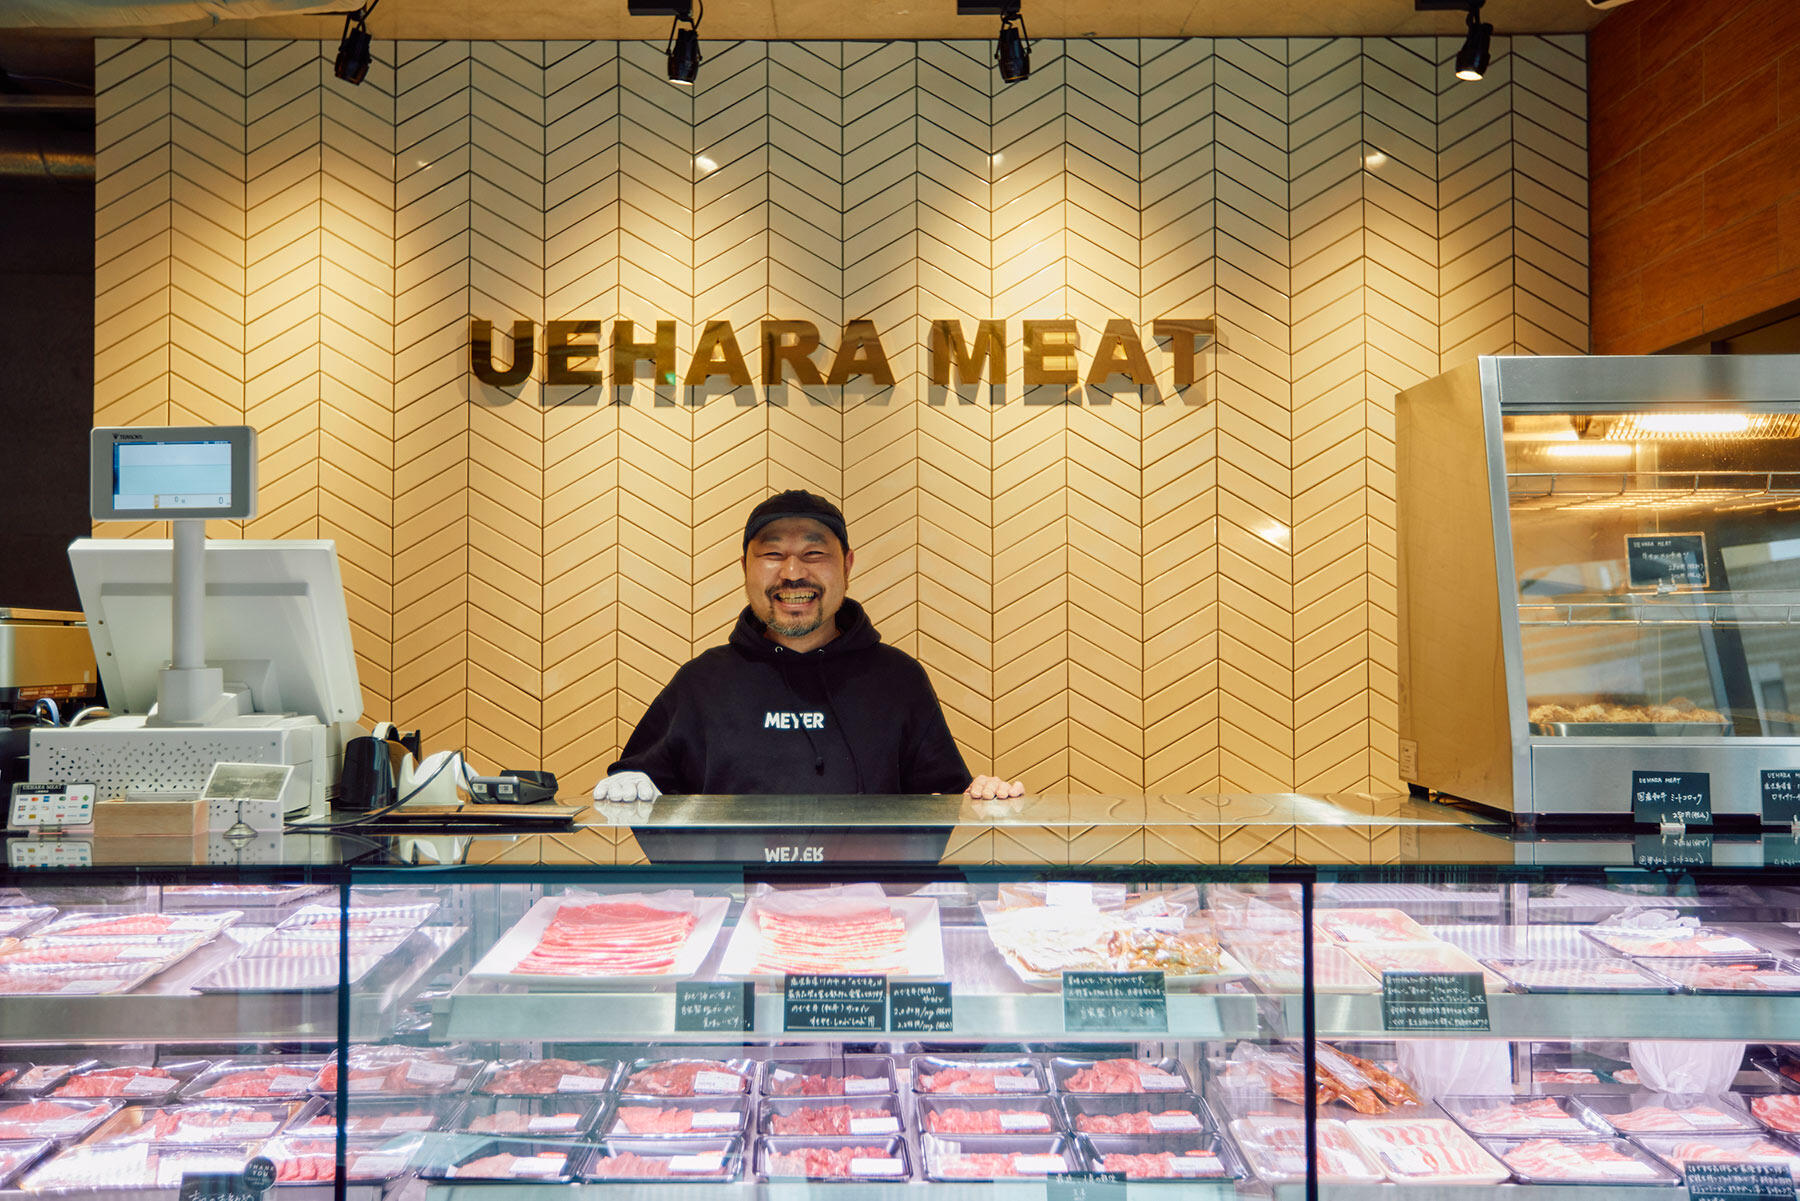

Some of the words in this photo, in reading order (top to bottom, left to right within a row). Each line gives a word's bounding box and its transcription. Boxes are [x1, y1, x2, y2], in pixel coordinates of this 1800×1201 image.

[471, 320, 896, 386] UEHARA
[931, 319, 1215, 385] MEAT
[764, 712, 825, 729] MEYER
